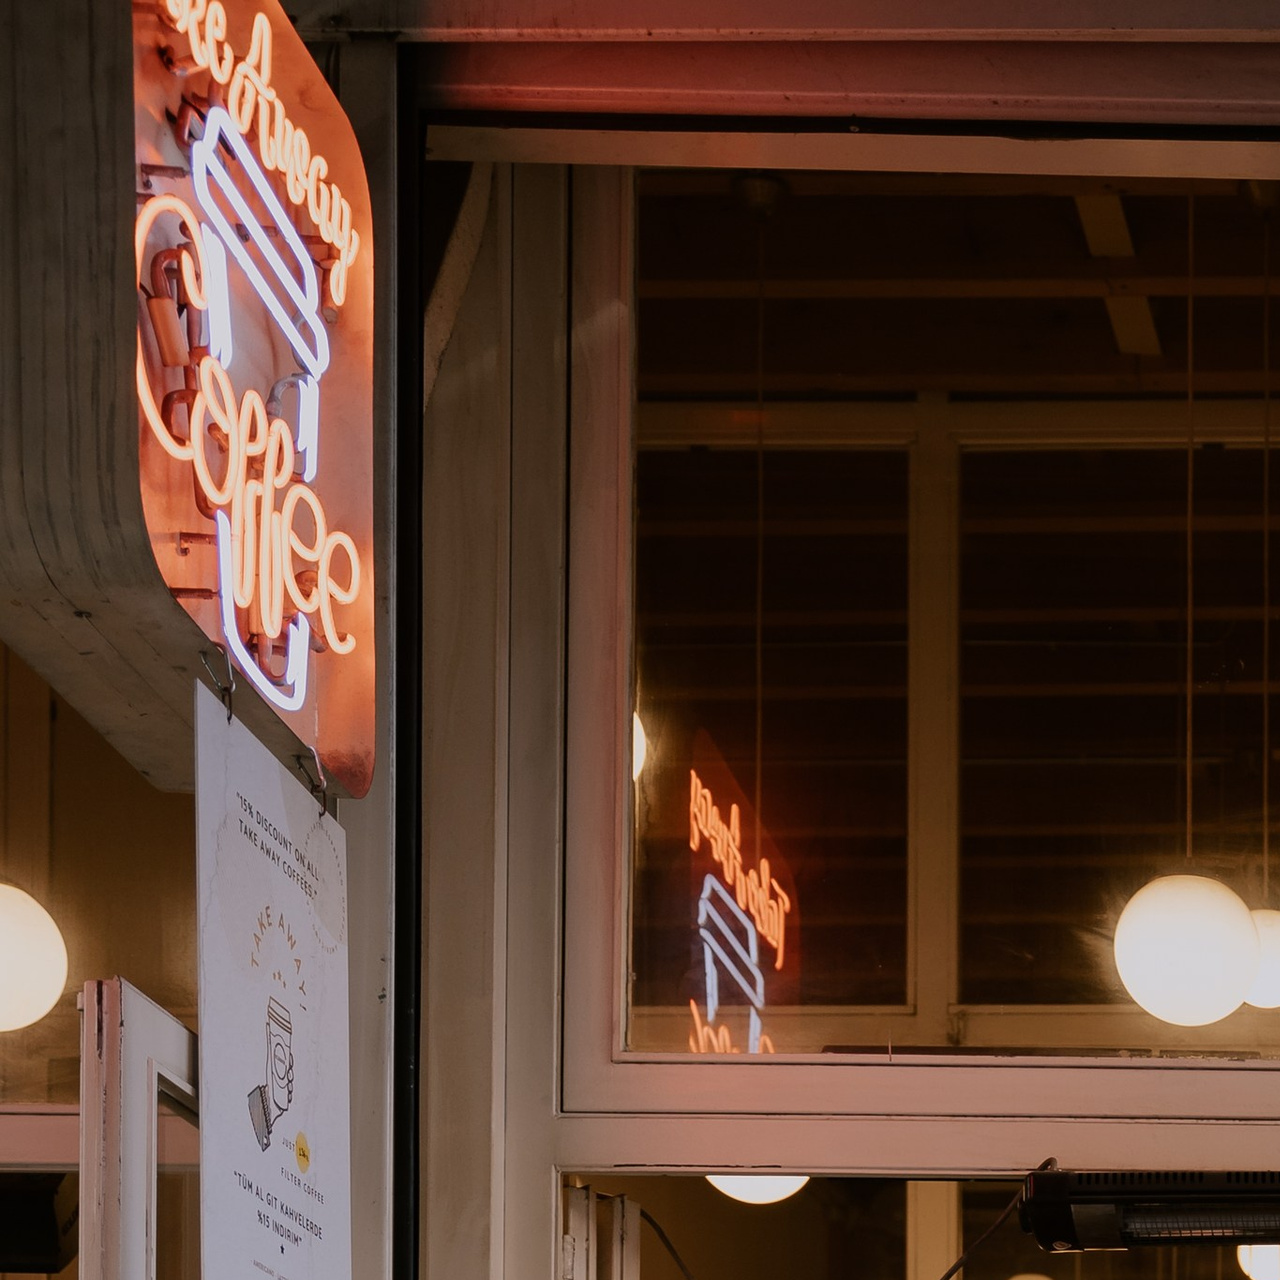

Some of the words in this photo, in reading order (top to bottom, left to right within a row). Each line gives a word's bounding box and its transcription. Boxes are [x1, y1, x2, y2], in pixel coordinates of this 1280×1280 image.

[134, 194, 361, 655] Coffee
[238, 818, 258, 848] TAKE
[260, 840, 281, 867] AWAY
[256, 810, 293, 855] DISCOUNT
[294, 848, 306, 869] ON
[306, 863, 320, 882] ALL
[251, 905, 273, 967] TAKE
[282, 1137, 296, 1152] JUST
[281, 1166, 302, 1188] FILTER
[303, 1183, 325, 1205] COFFEE
[255, 1186, 265, 1202] AL
[280, 1200, 323, 1241] KAHVELERDE
[257, 1209, 271, 1229] %15
